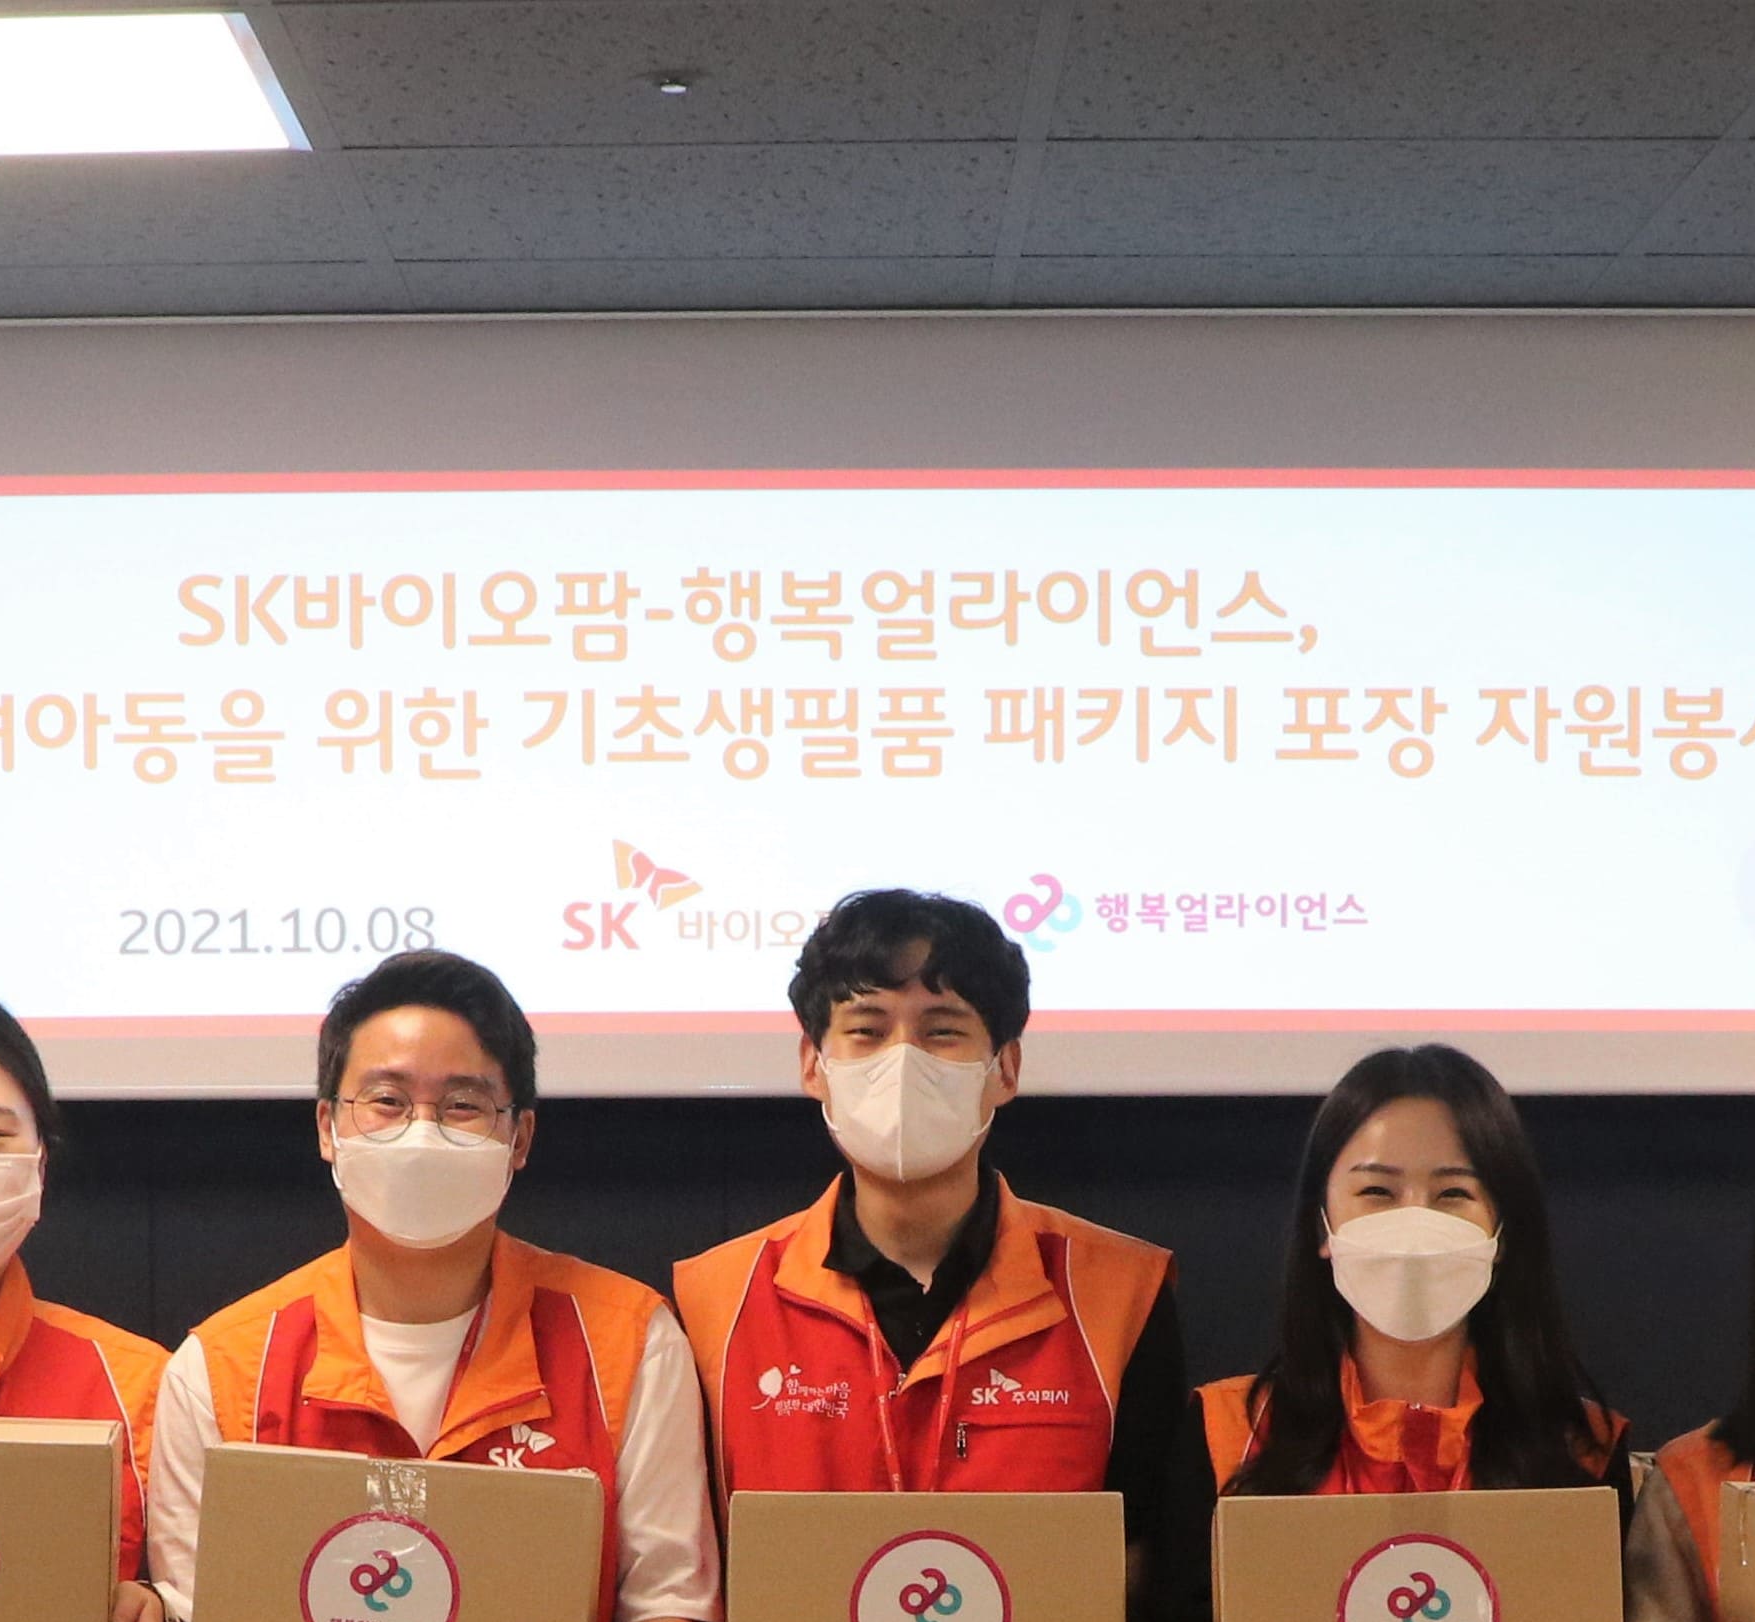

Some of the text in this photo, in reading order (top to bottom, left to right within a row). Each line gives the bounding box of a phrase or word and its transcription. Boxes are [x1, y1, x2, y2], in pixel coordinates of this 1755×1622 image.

[179, 568, 1317, 661] SK바이오팜-행복얼라이언스,
[317, 688, 489, 779] 위한
[524, 685, 954, 779] 기초생필품
[985, 687, 1237, 761] 패키지
[1277, 688, 1447, 778] 포장
[119, 905, 436, 957] 2021.10.08
[563, 902, 830, 951] SK 바이오
[1096, 893, 1367, 933] 행복얼라이언스
[971, 1387, 1070, 1405] SK 주식회사
[488, 1447, 526, 1469] SK
